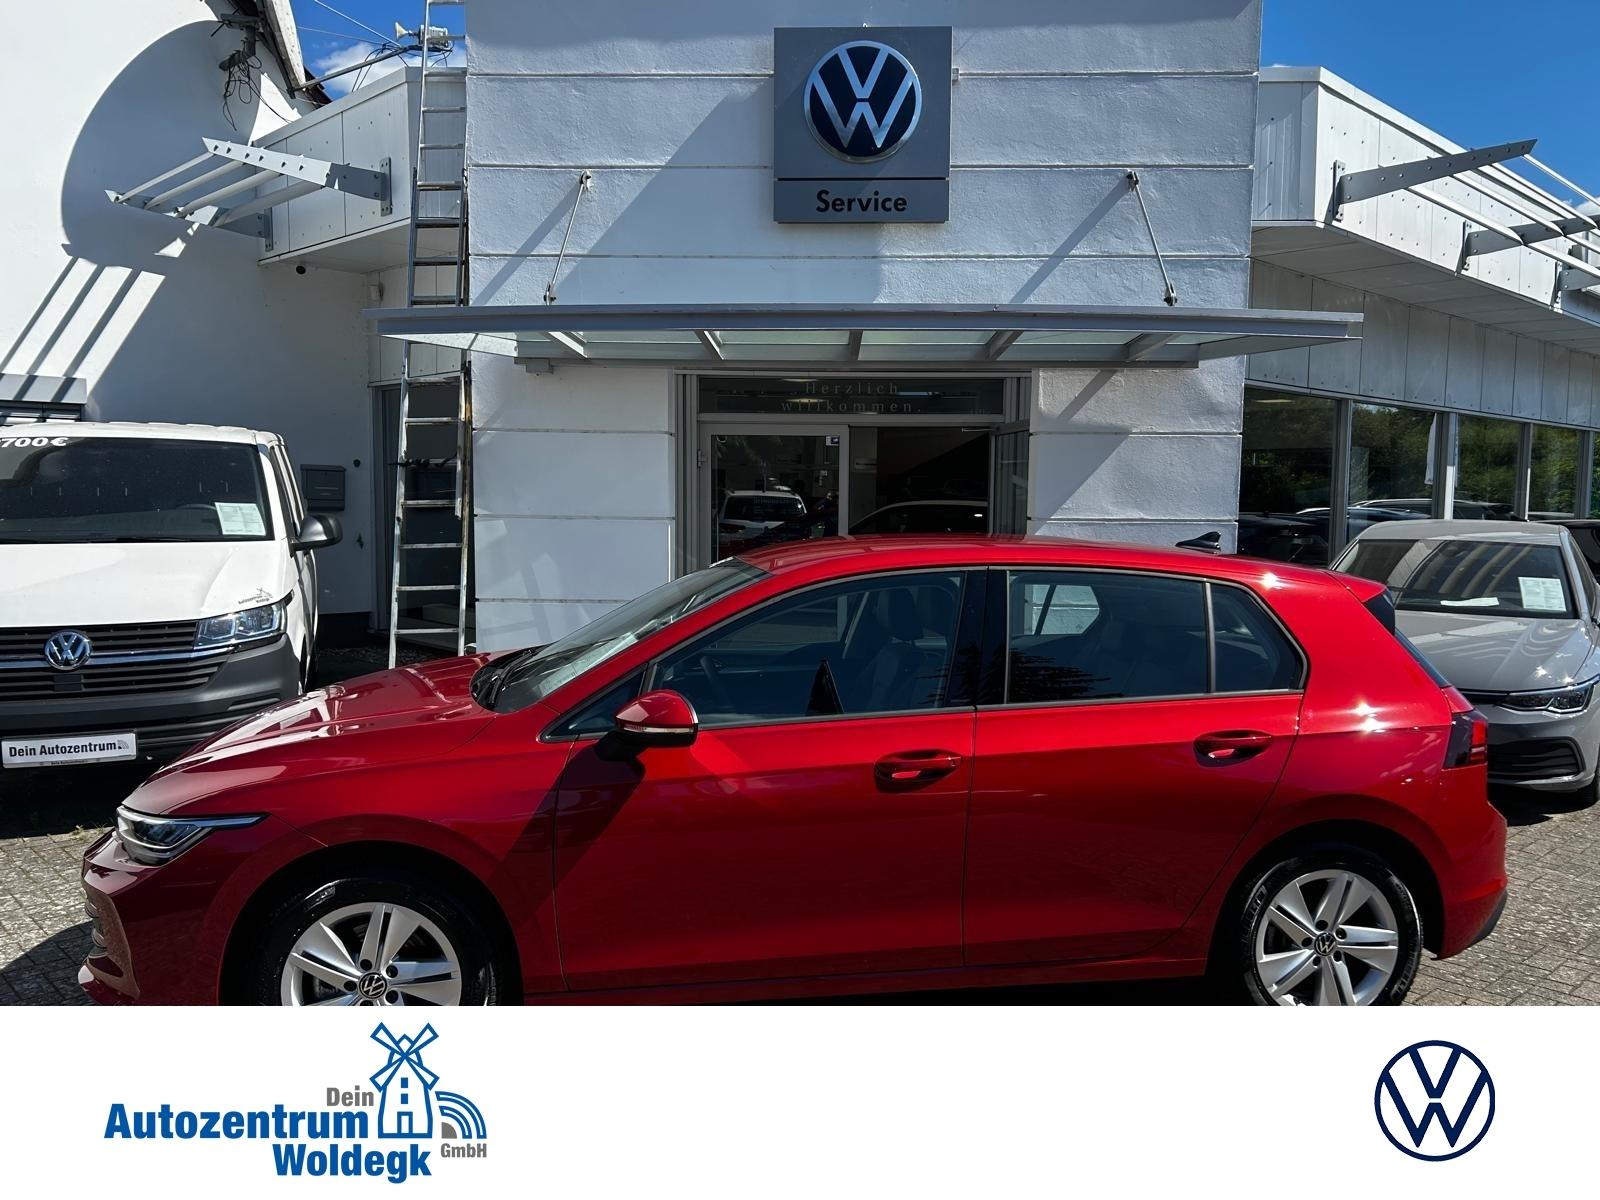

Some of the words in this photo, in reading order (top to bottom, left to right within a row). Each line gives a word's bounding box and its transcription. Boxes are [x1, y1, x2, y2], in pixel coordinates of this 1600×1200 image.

[807, 43, 919, 153] VW
[815, 189, 907, 212] Service
[804, 381, 900, 396] Herzlich
[9, 745, 36, 757] Dein
[39, 741, 117, 756] Autozentrum
